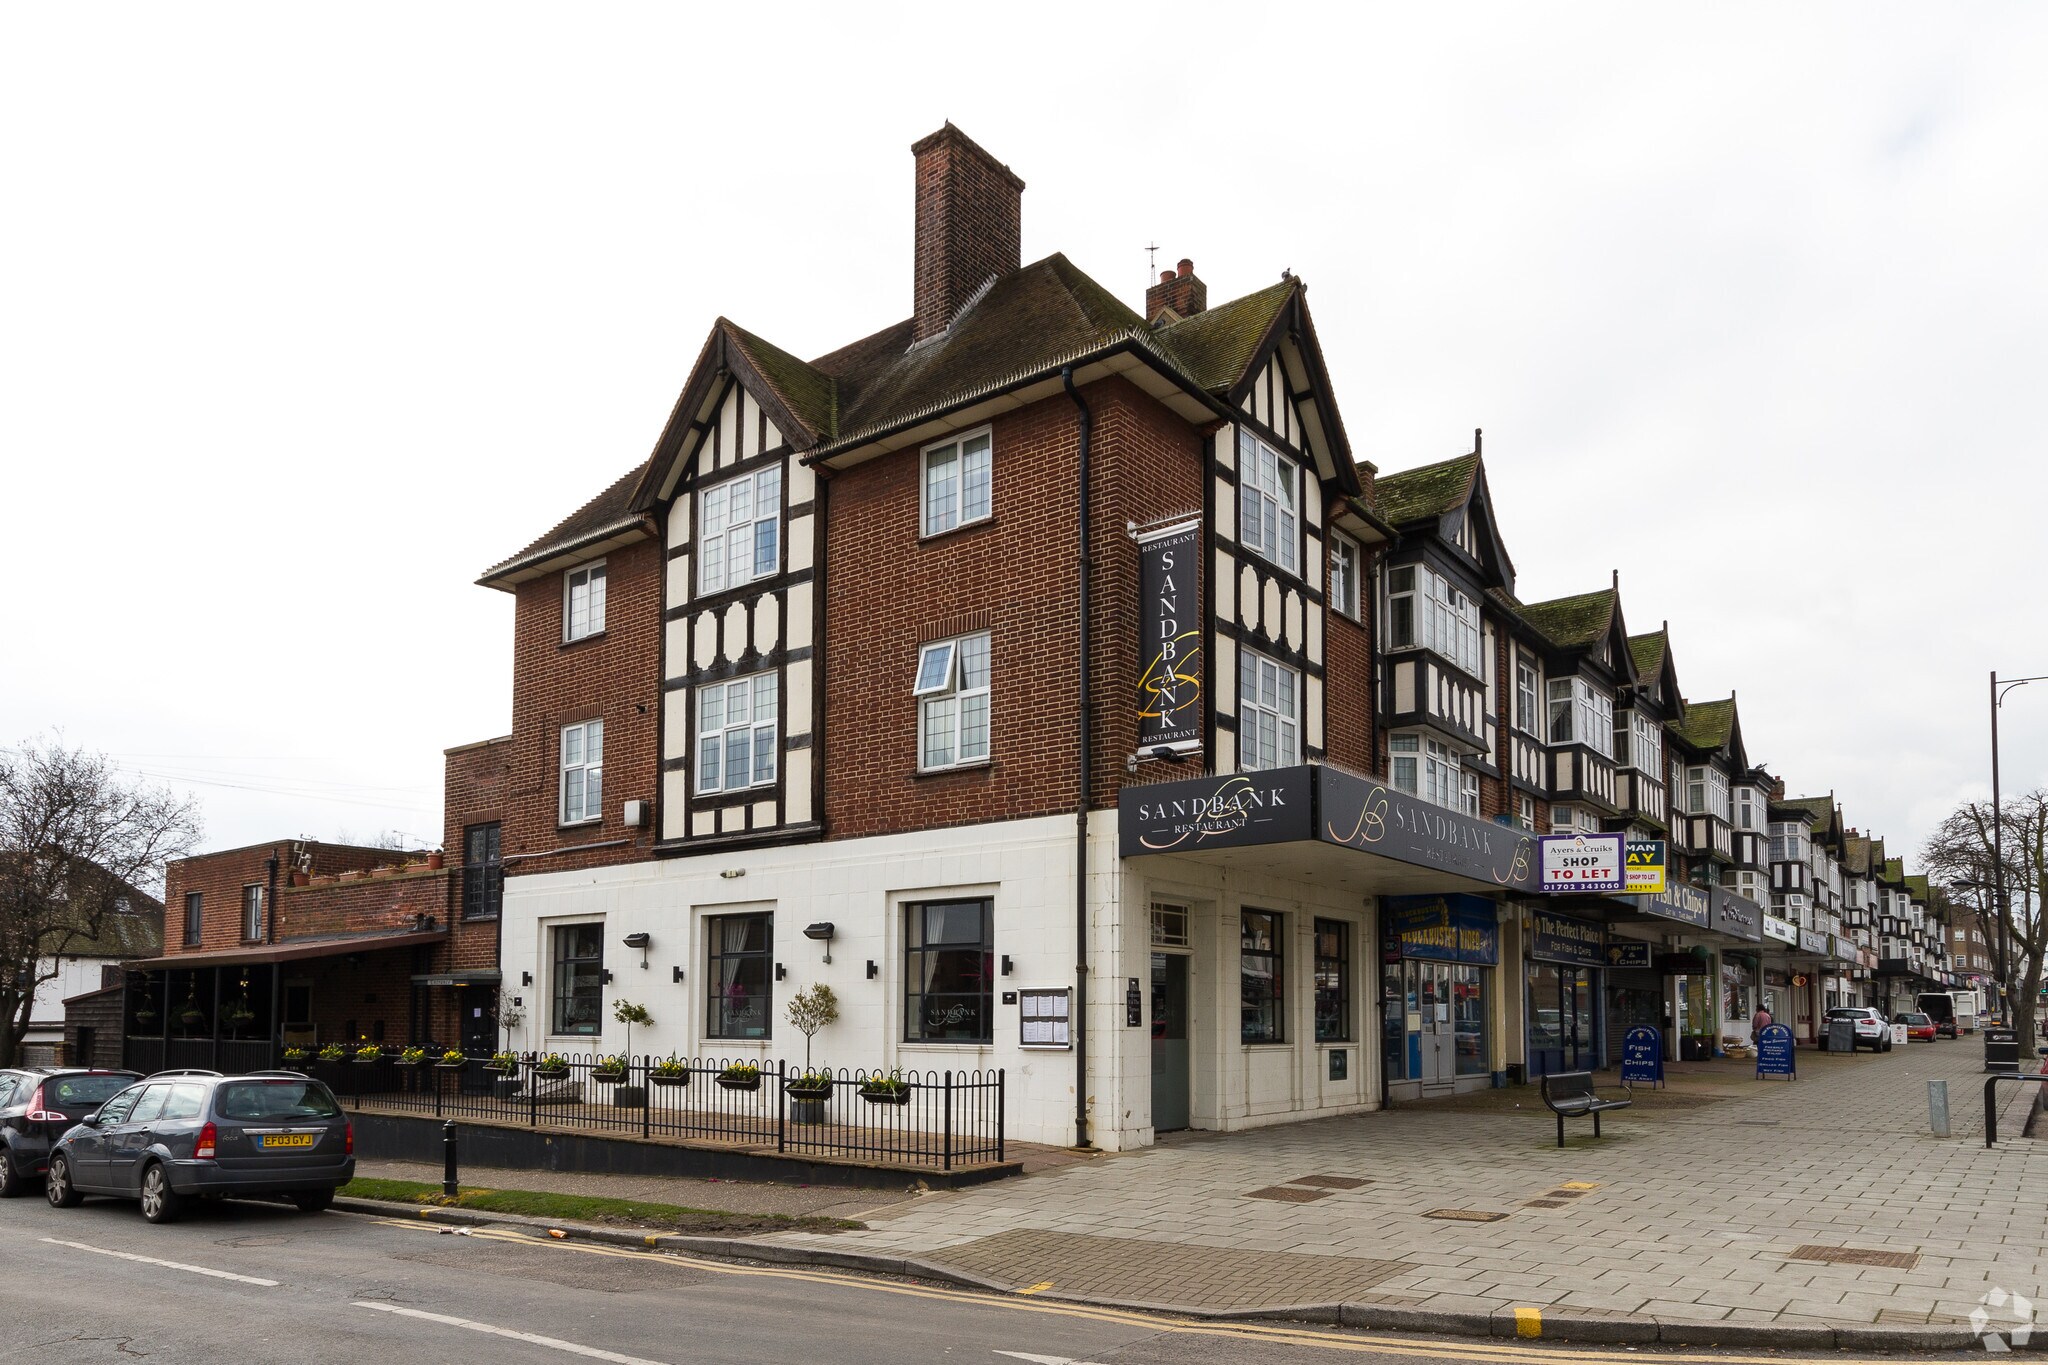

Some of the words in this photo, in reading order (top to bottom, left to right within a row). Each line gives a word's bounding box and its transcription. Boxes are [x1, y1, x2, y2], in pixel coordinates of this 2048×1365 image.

[1142, 533, 1197, 553] RESTAURANT
[1159, 550, 1178, 730] SANDBANK
[1142, 728, 1197, 743] RESTAURANT
[1139, 788, 1287, 821] SANDBANK
[1174, 818, 1248, 834] RESTAURANT
[1396, 803, 1492, 856] SANDBANK
[1550, 847, 1574, 856] Ayers
[1583, 845, 1613, 853] Cruiks
[1563, 856, 1599, 867] SHOP
[1551, 870, 1574, 880] TO
[1581, 868, 1611, 879] LET
[1580, 882, 1620, 890] 343060
[1673, 885, 1681, 908] &
[1682, 887, 1702, 919] Chips
[1540, 916, 1555, 935] The
[1556, 919, 1579, 940] Perfect
[1579, 924, 1599, 943] Plaice
[1459, 928, 1481, 951] VIDEO
[930, 1008, 976, 1016] SANDBANK
[1628, 1044, 1651, 1052] FISH
[1624, 1059, 1654, 1067] CHIPS
[264, 1136, 291, 1145] EF03
[292, 1135, 312, 1145] GYJ
